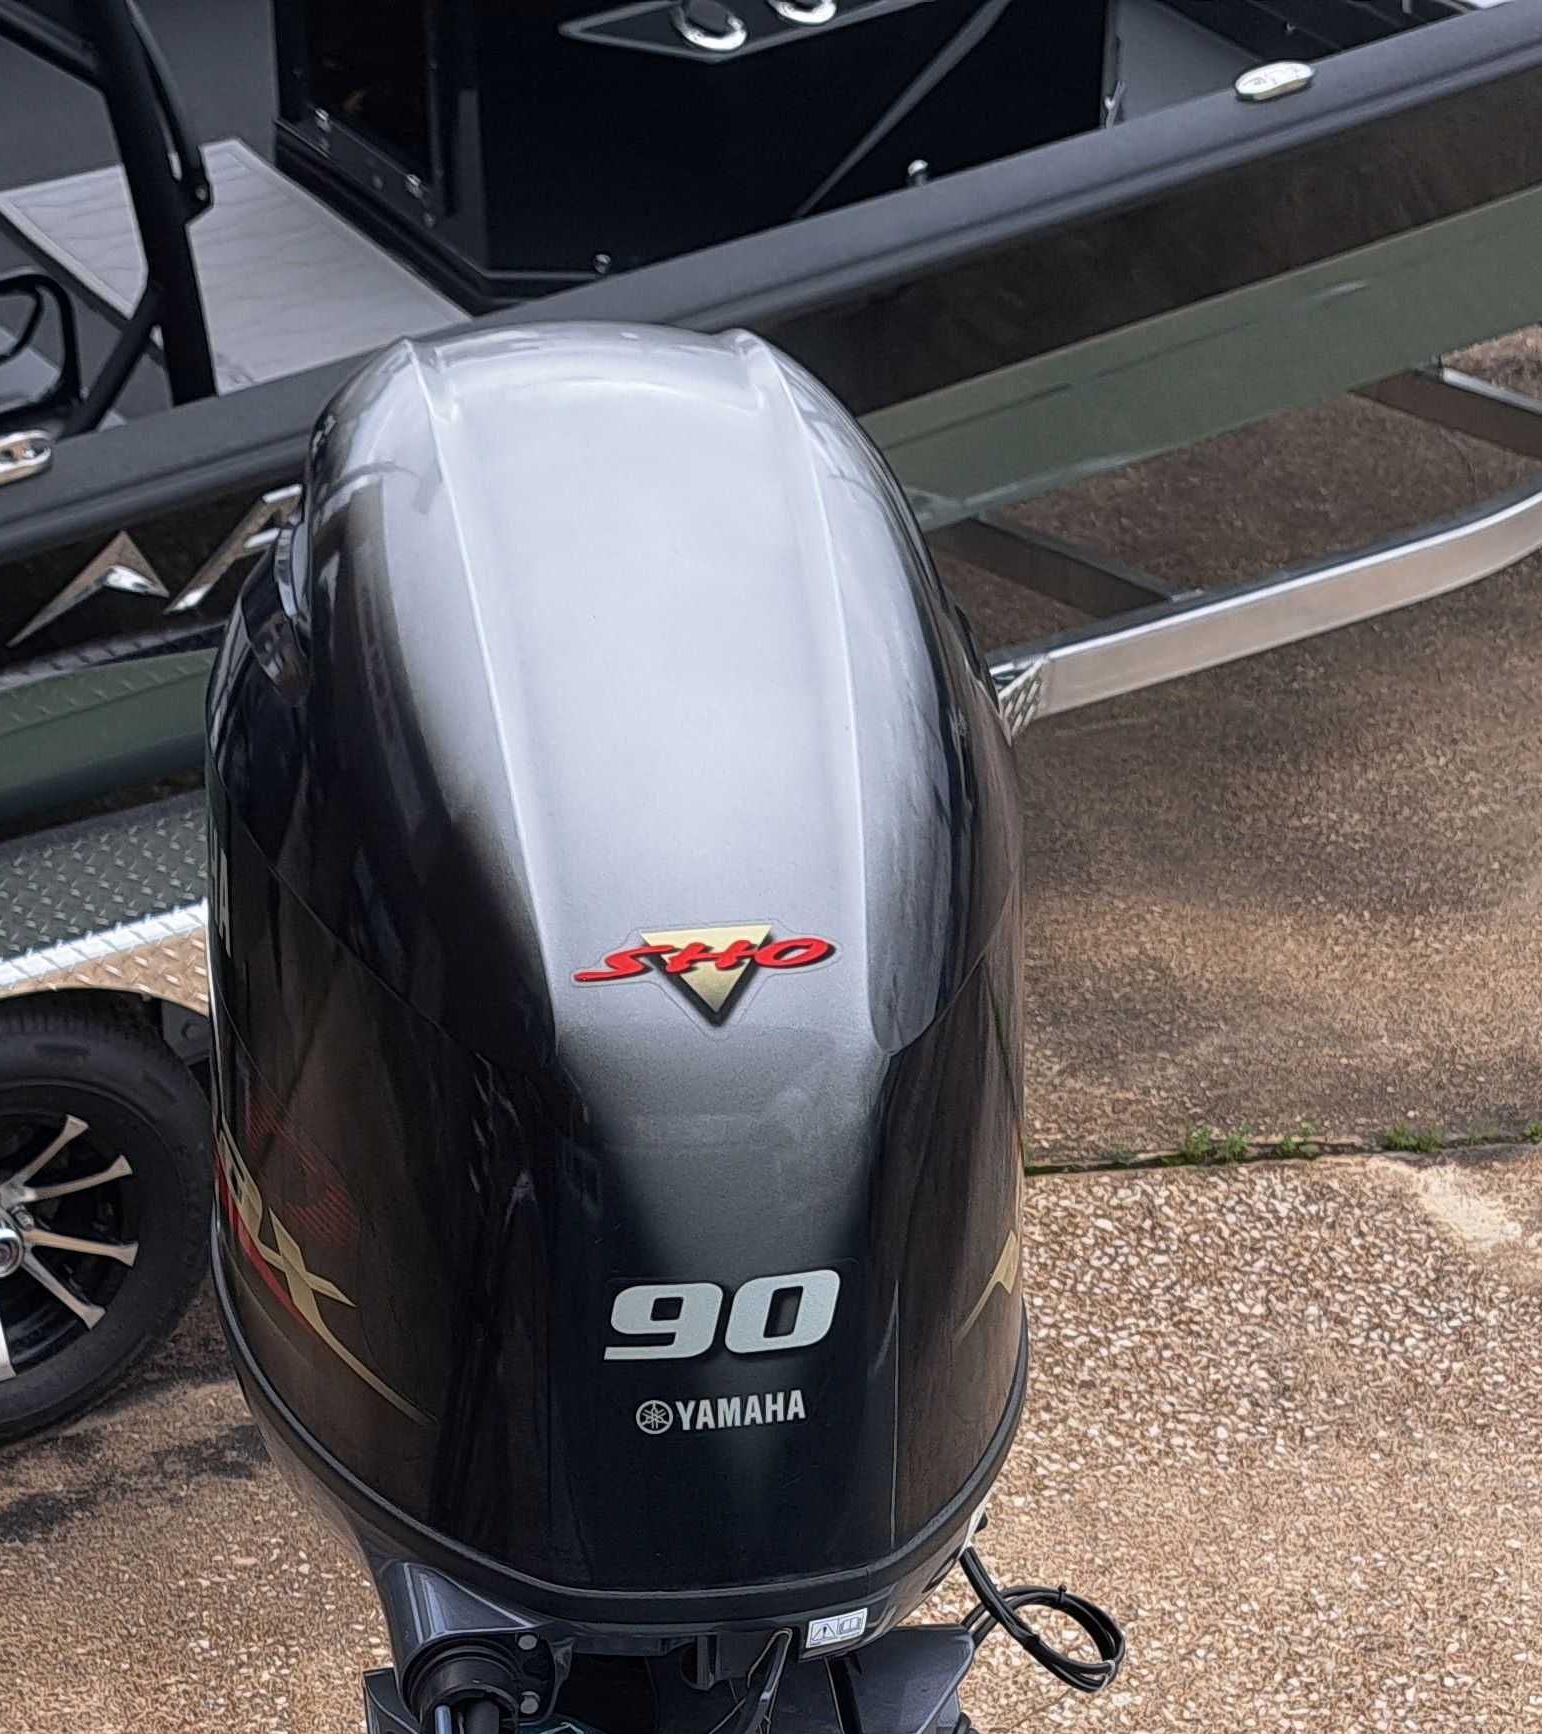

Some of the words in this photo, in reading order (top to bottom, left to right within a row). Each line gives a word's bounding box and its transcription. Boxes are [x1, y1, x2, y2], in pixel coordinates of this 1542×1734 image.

[573, 936, 835, 983] SHO
[603, 1268, 841, 1361] 90
[674, 1389, 807, 1432] YAMAHA
